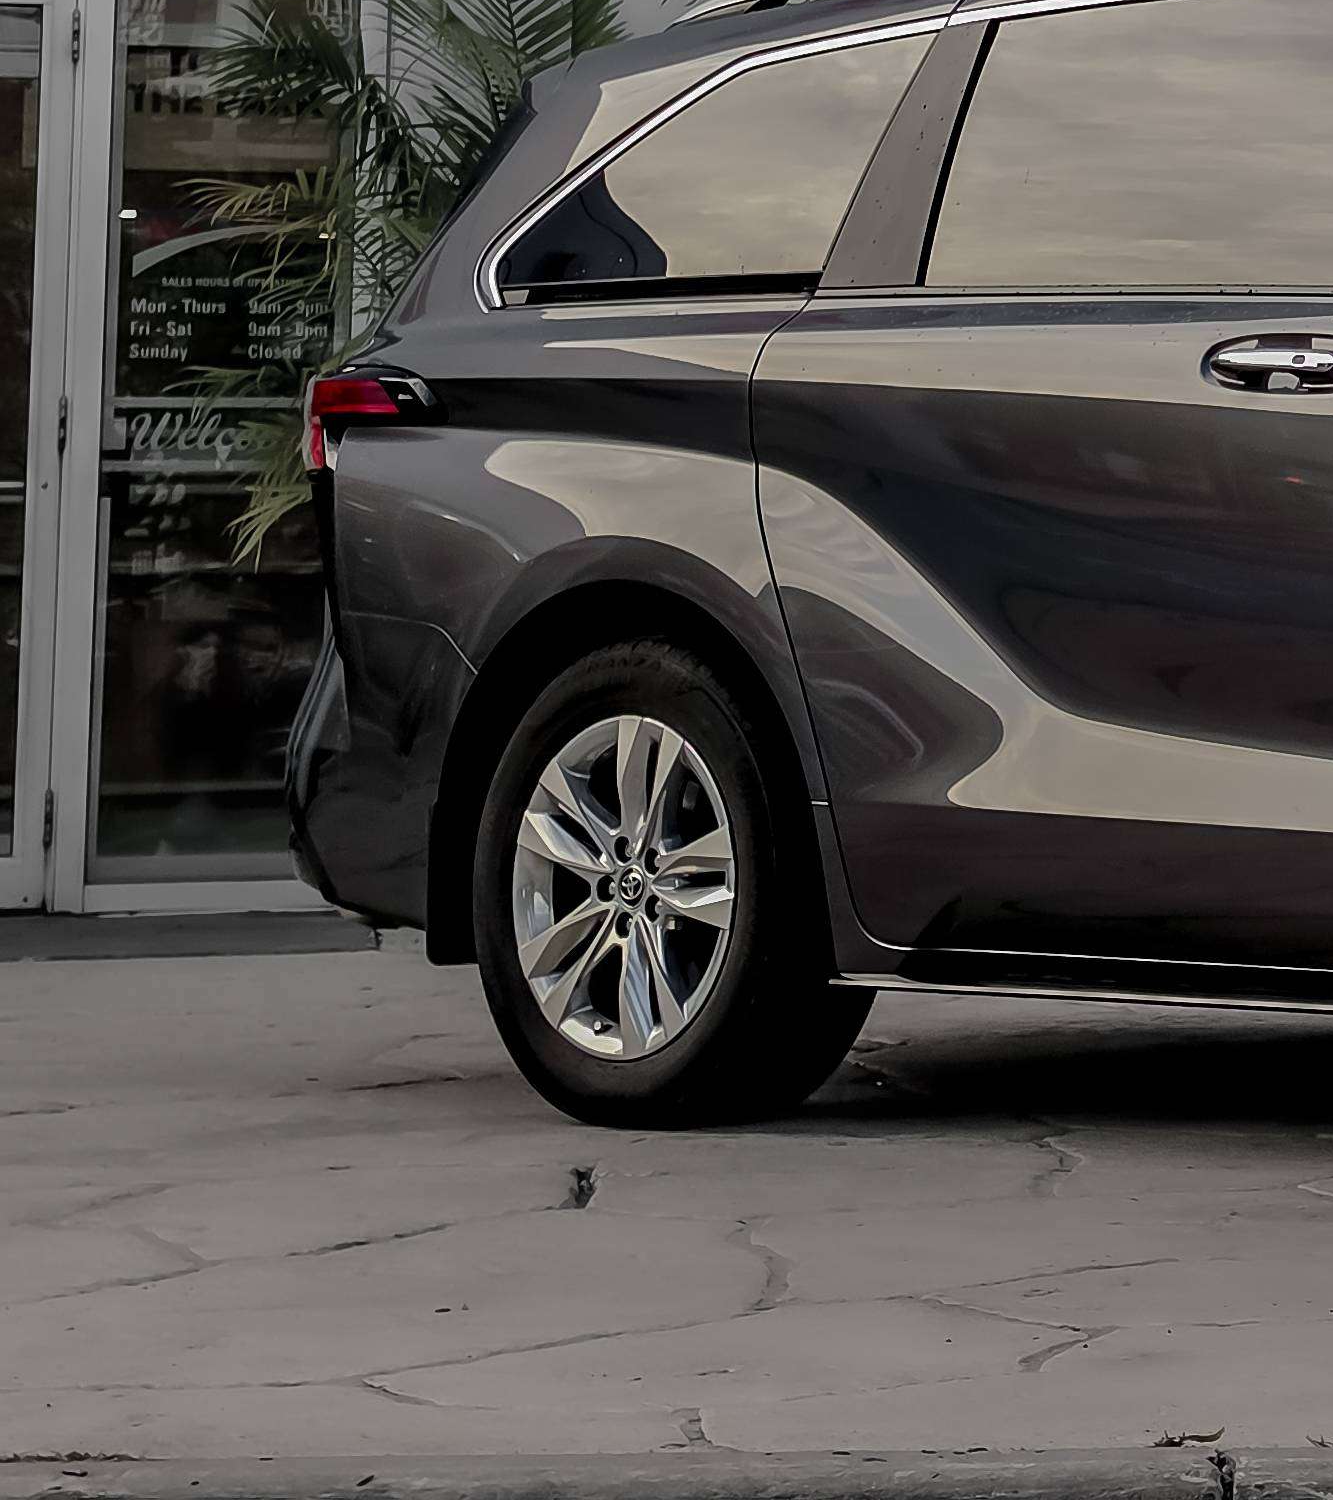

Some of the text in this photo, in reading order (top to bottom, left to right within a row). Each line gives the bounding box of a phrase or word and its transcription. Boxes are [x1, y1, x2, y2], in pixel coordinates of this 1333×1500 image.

[130, 298, 167, 314] Mon
[182, 298, 226, 314] Thurs
[129, 321, 150, 336] Fri
[166, 321, 192, 337] Sat
[248, 321, 281, 337] 9am
[129, 343, 188, 362] Sunday
